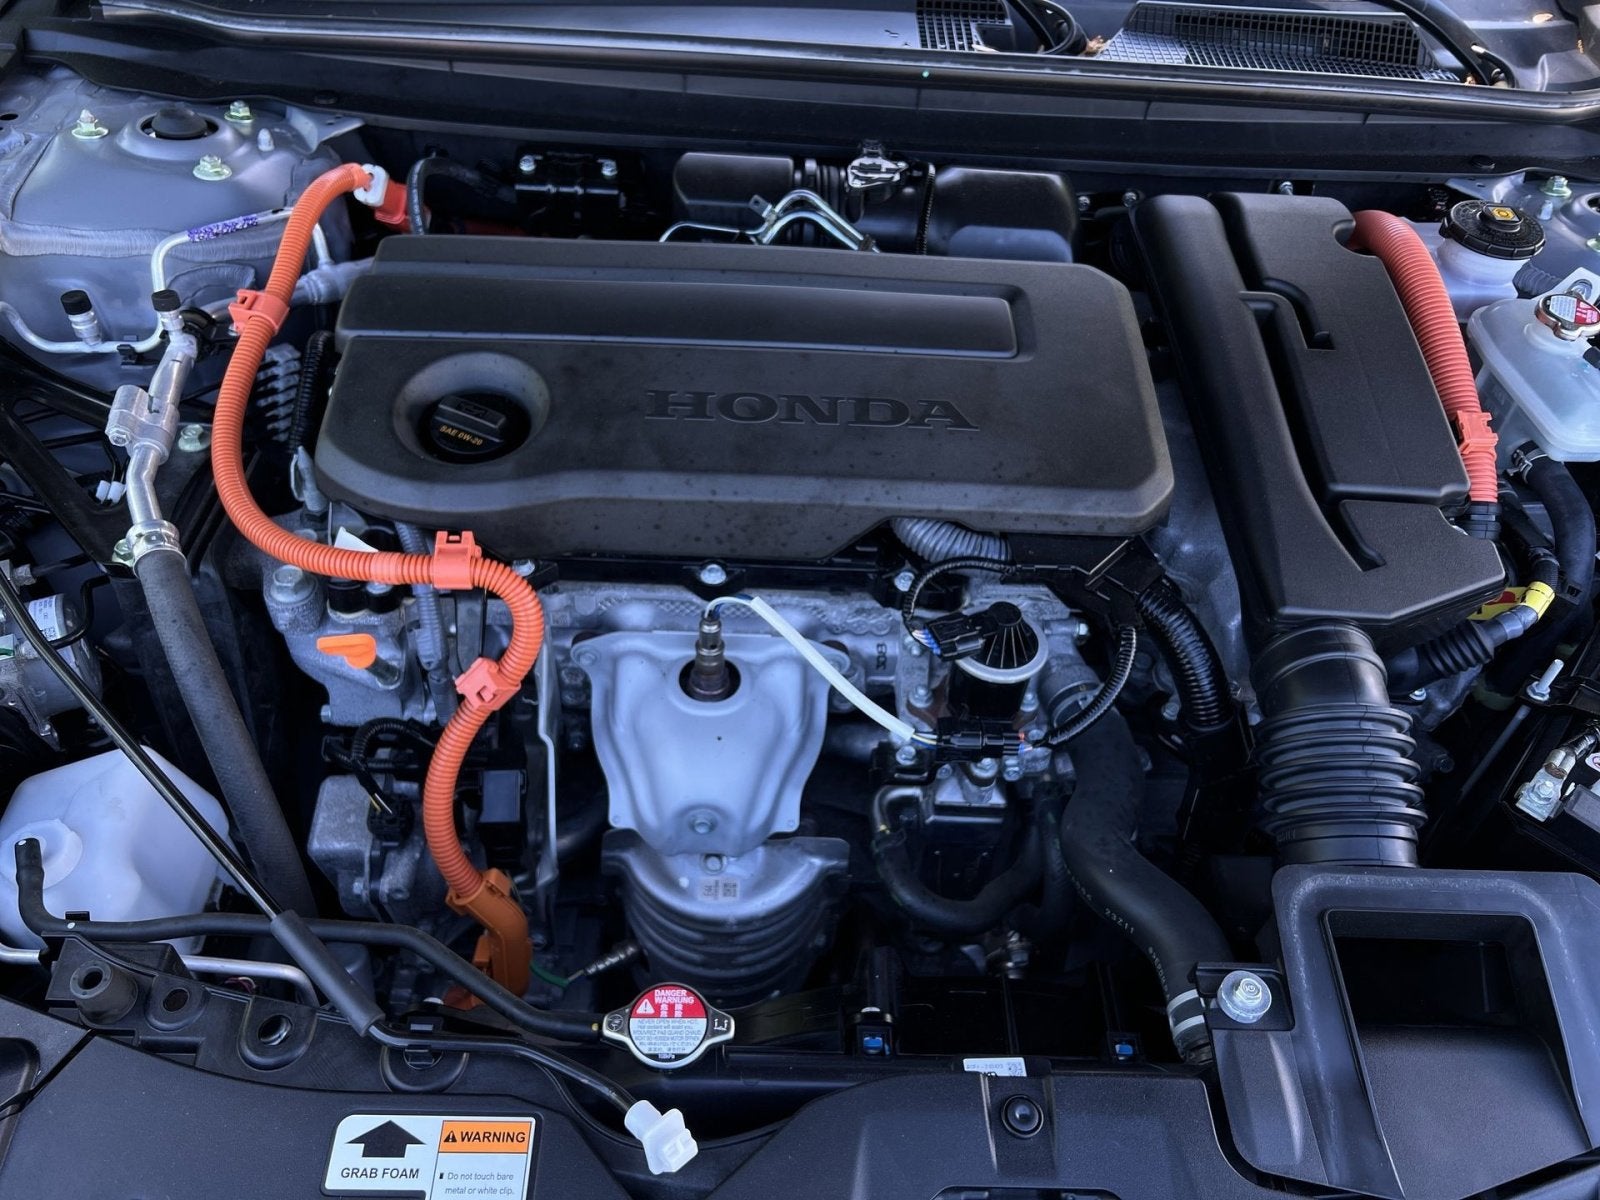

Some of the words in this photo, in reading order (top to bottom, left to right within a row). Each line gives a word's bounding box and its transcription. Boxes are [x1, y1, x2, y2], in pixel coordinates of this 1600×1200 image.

[645, 388, 981, 432] HONDA
[439, 425, 457, 437] SAE
[458, 431, 484, 446] 0W-20
[655, 996, 694, 1004] WARNUNG
[460, 1132, 526, 1143] WARNING
[340, 1167, 378, 1179] GRAB
[381, 1167, 420, 1179] FOAM
[447, 1172, 459, 1180] Do
[475, 1172, 495, 1181] touch
[497, 1172, 514, 1180] bare
[445, 1186, 466, 1194] metal
[478, 1186, 498, 1194] white
[499, 1186, 514, 1196] clip.
